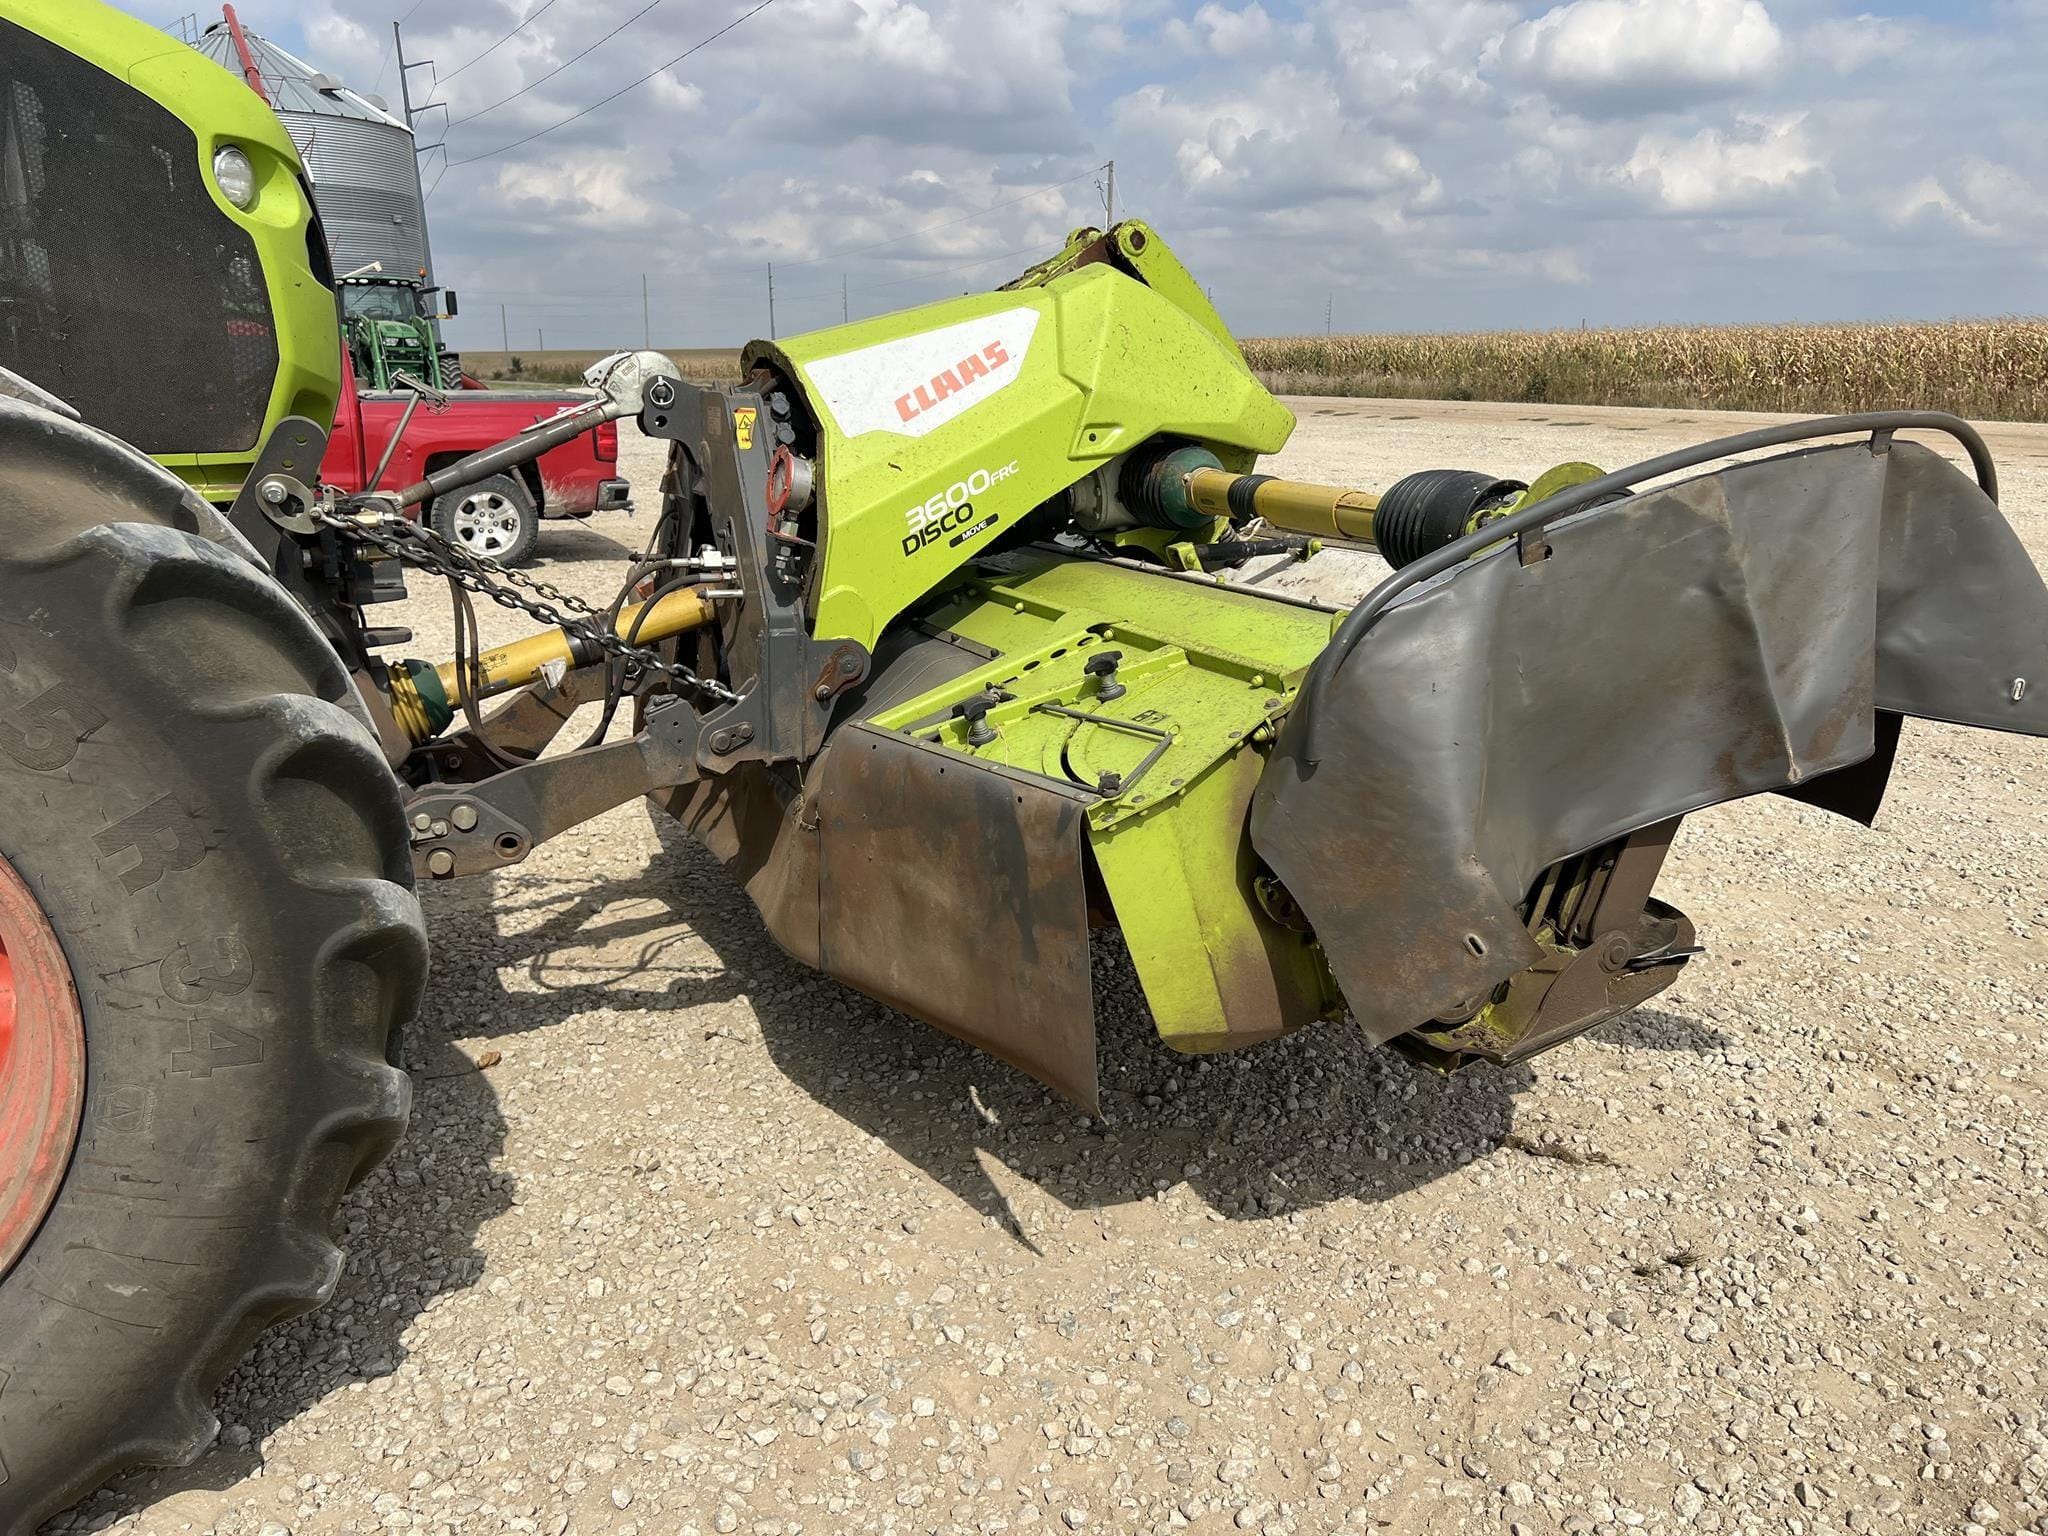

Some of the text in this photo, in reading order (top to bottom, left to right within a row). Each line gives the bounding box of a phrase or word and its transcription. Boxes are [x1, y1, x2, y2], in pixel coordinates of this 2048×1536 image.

[894, 340, 1009, 422] CLAAS
[902, 502, 974, 557] DISCO
[905, 468, 990, 535] 3600
[961, 520, 988, 541] MOVE
